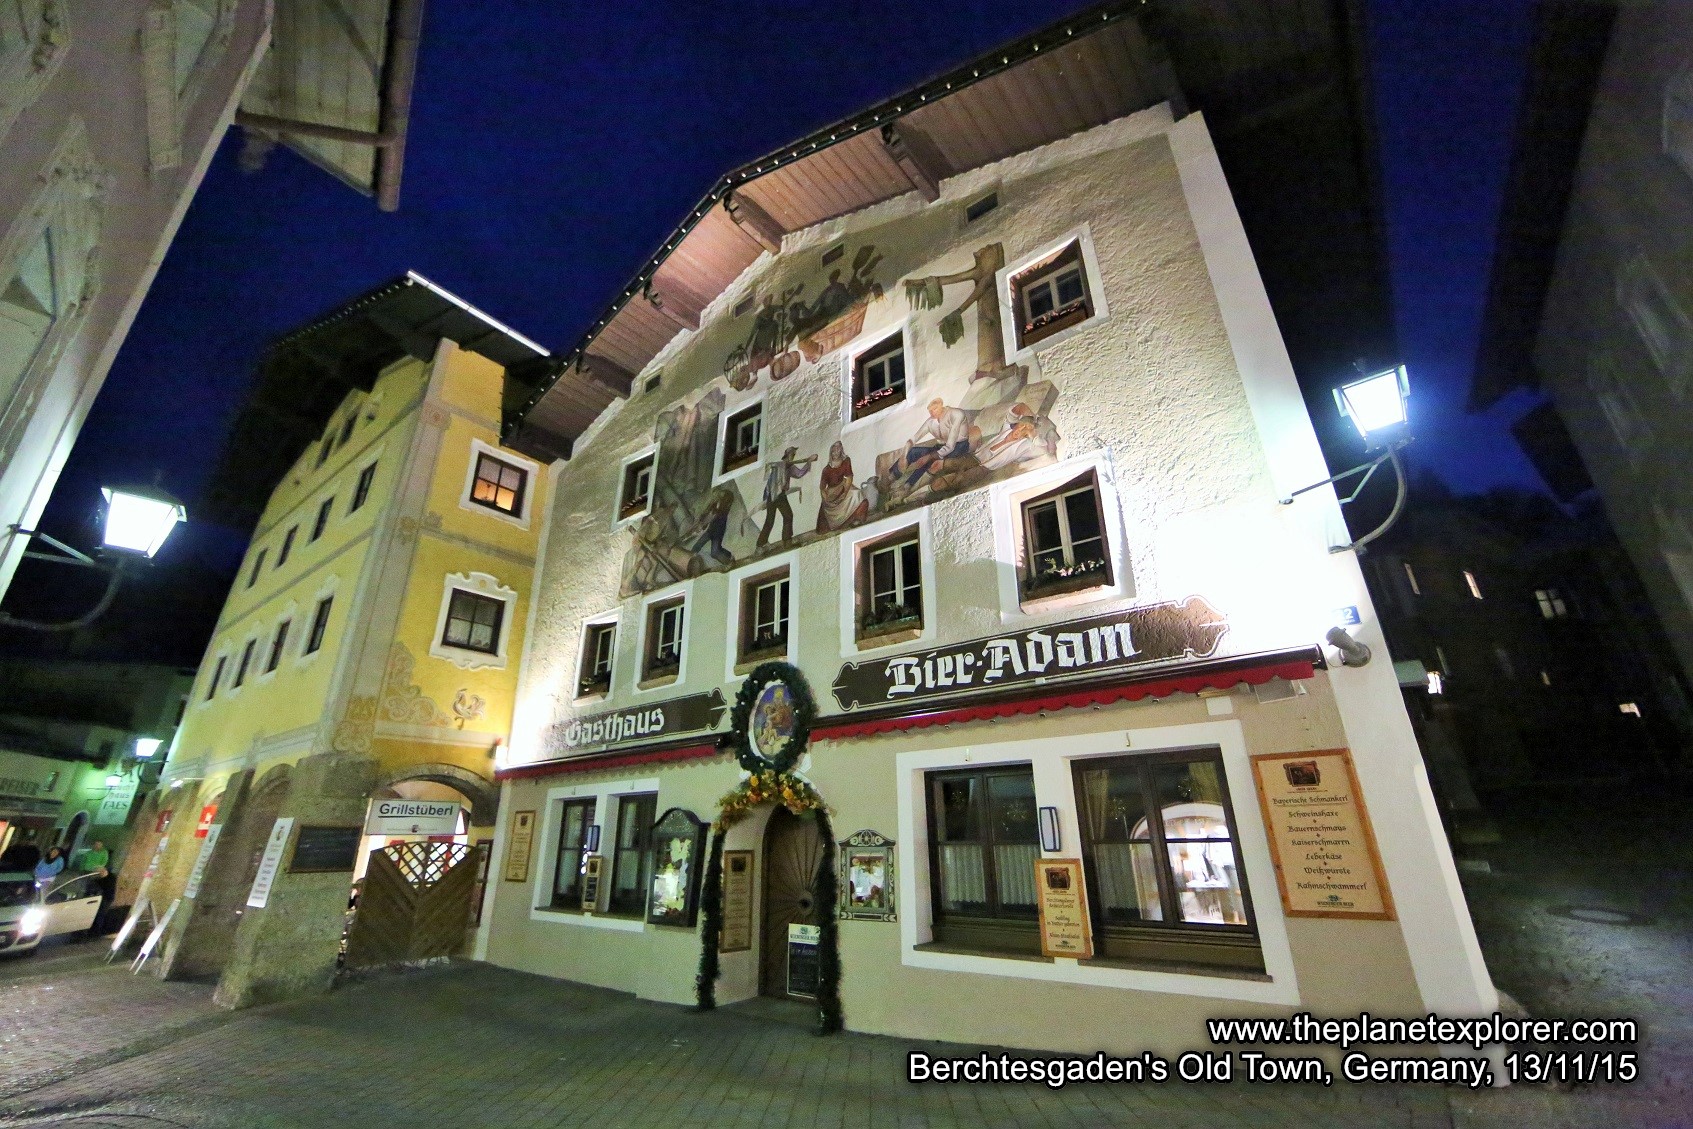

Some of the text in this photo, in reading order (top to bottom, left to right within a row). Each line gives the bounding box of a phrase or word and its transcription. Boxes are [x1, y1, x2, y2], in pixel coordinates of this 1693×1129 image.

[565, 708, 665, 747] Gasthaus
[1272, 795, 1348, 805] Bayerische Schmankerl
[379, 803, 453, 816] Grillstüberl
[1289, 810, 1339, 818] Schweinshaxe
[1291, 838, 1350, 846] Kaiserschmarrn
